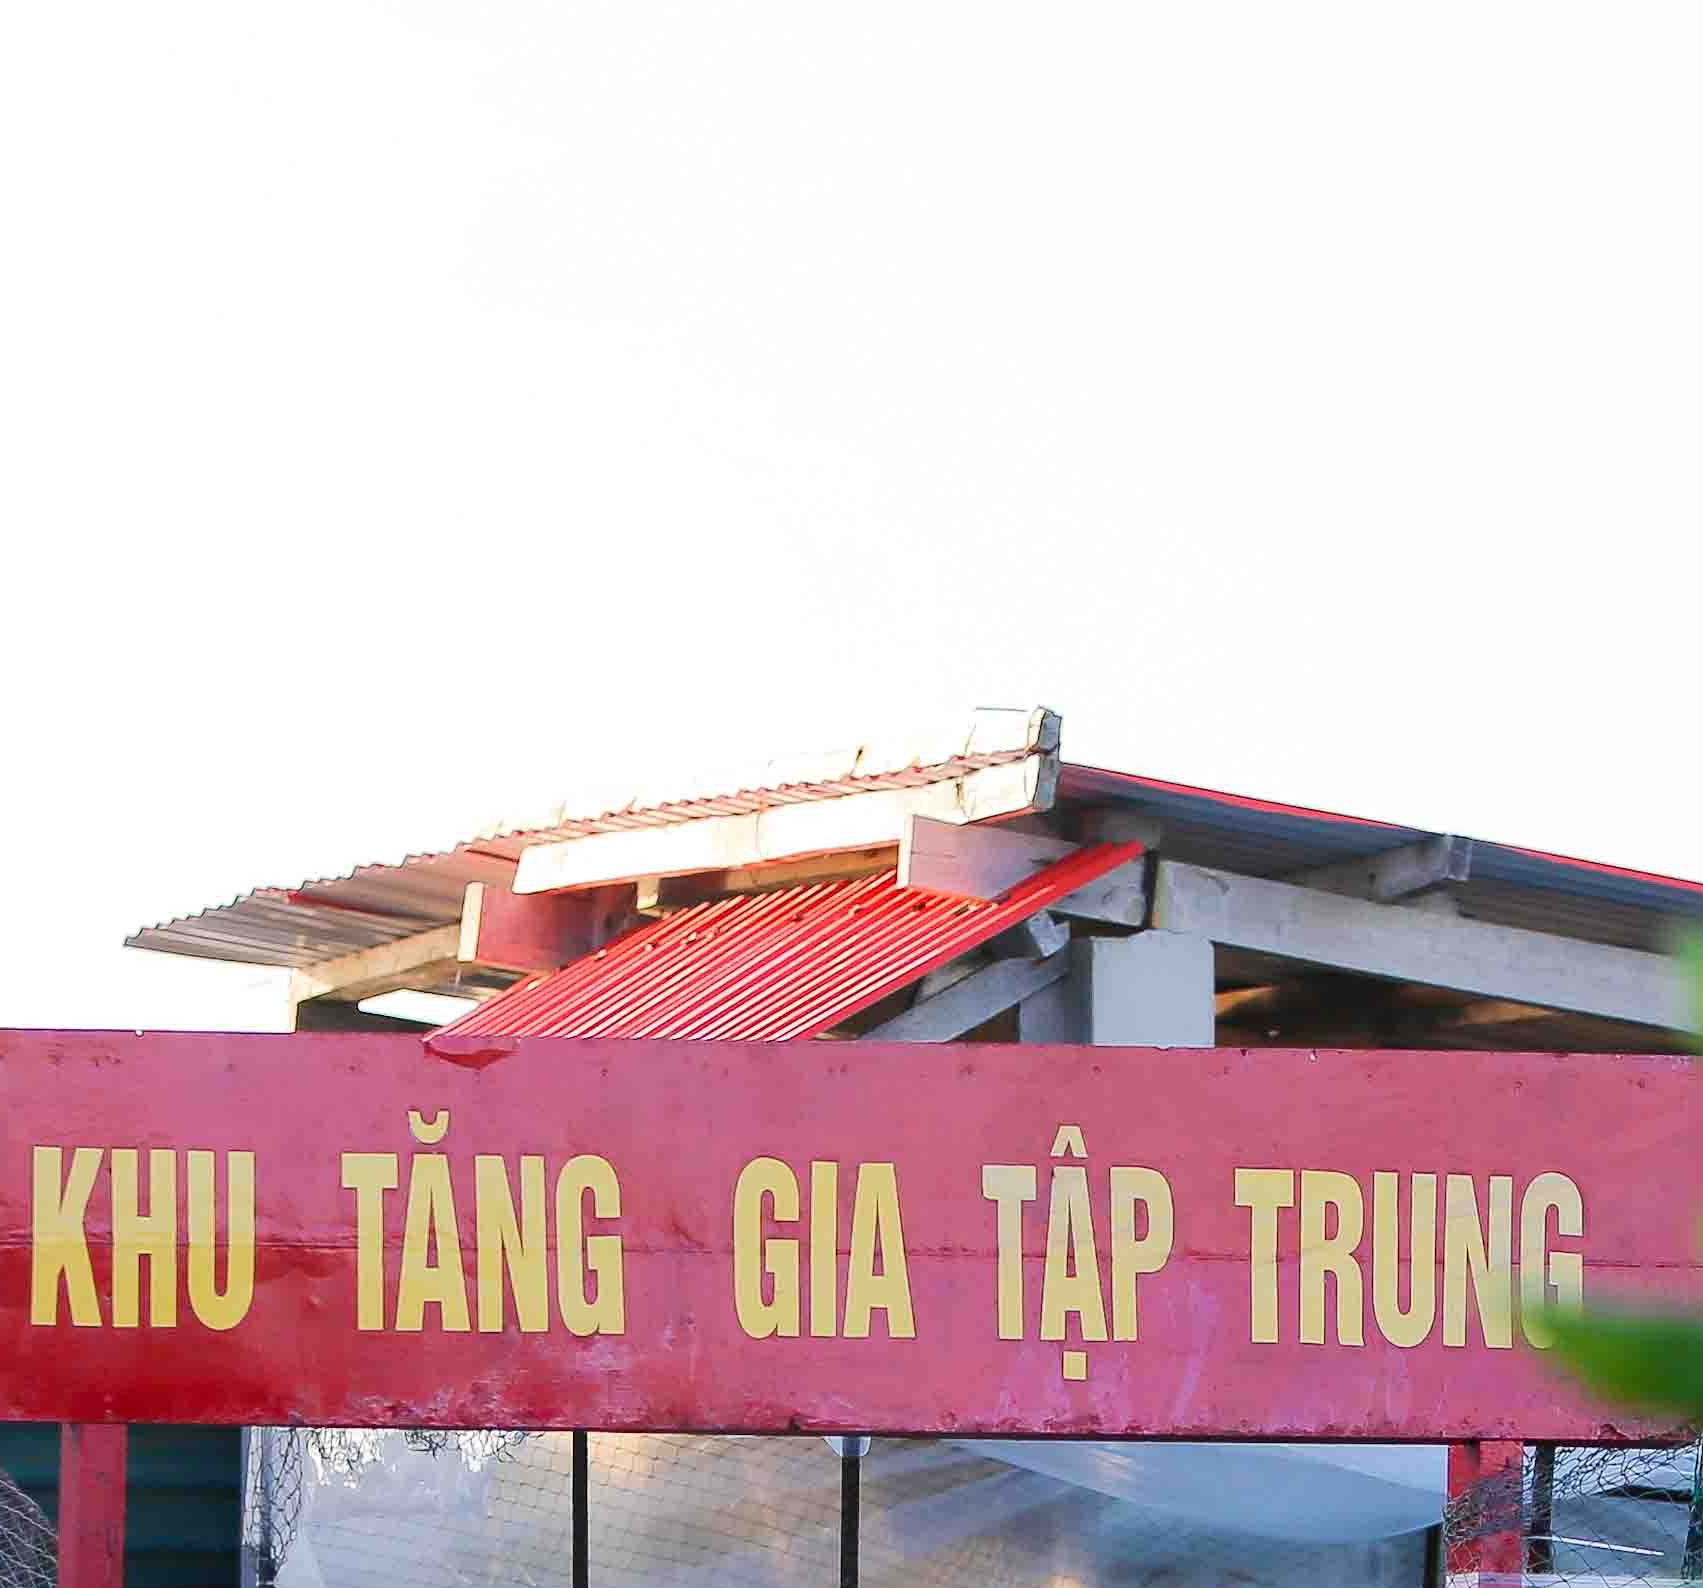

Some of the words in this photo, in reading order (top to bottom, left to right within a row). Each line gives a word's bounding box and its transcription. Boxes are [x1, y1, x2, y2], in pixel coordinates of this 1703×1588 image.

[29, 1145, 257, 1331] KHU
[339, 1110, 626, 1337] TĂNG
[732, 1157, 917, 1340] GIA
[981, 1125, 1176, 1381] TẬP
[1233, 1167, 1585, 1350] TRUNG
